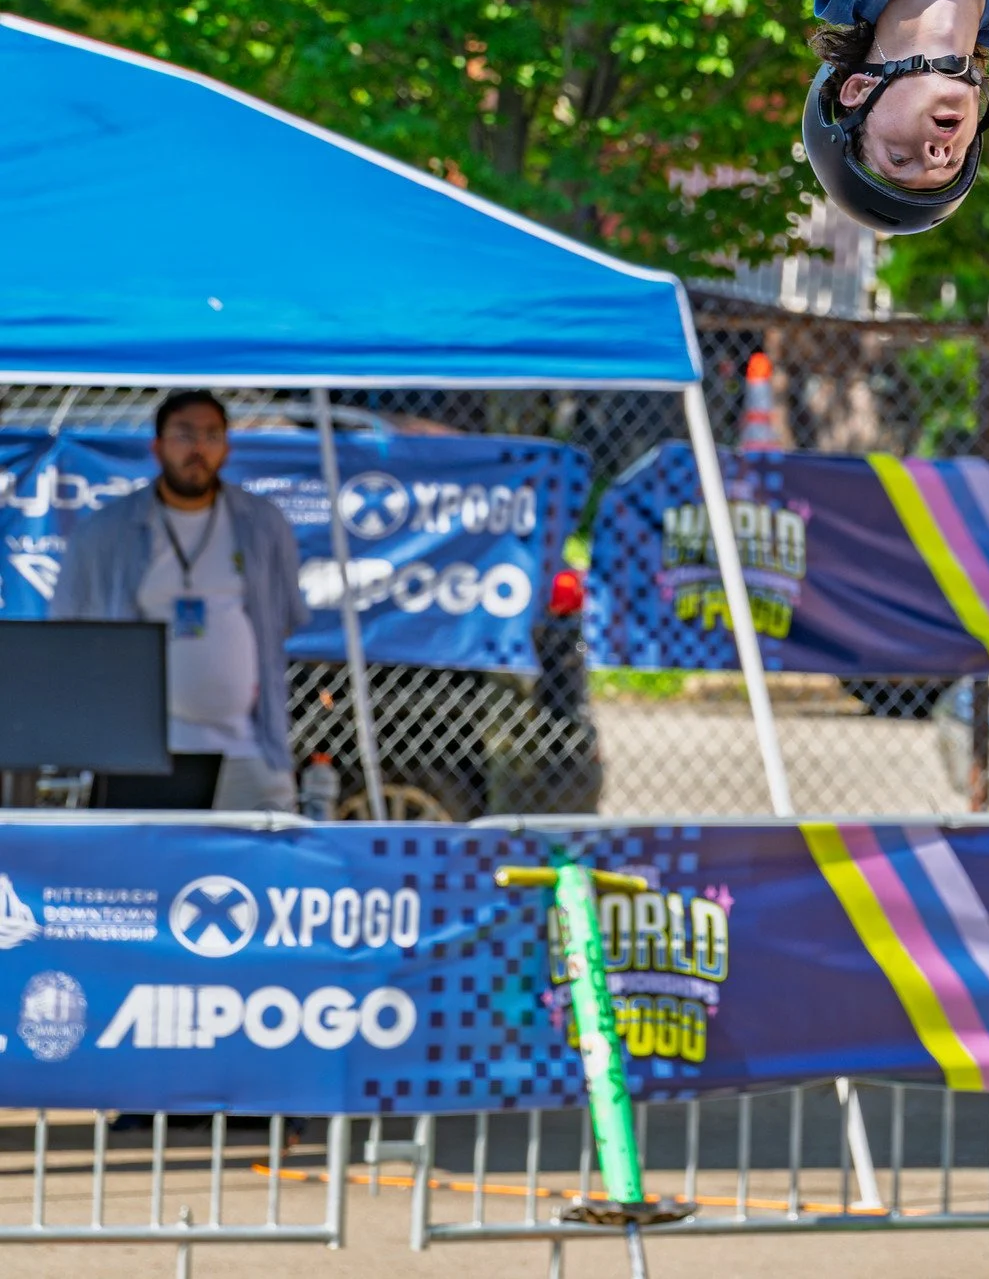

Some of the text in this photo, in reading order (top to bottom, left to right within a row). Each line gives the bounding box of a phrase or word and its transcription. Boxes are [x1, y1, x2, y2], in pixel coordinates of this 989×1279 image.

[411, 481, 538, 536] XPOGO
[662, 499, 806, 580] WRLD
[263, 886, 421, 948] XPOGO
[548, 892, 728, 983] ORLD
